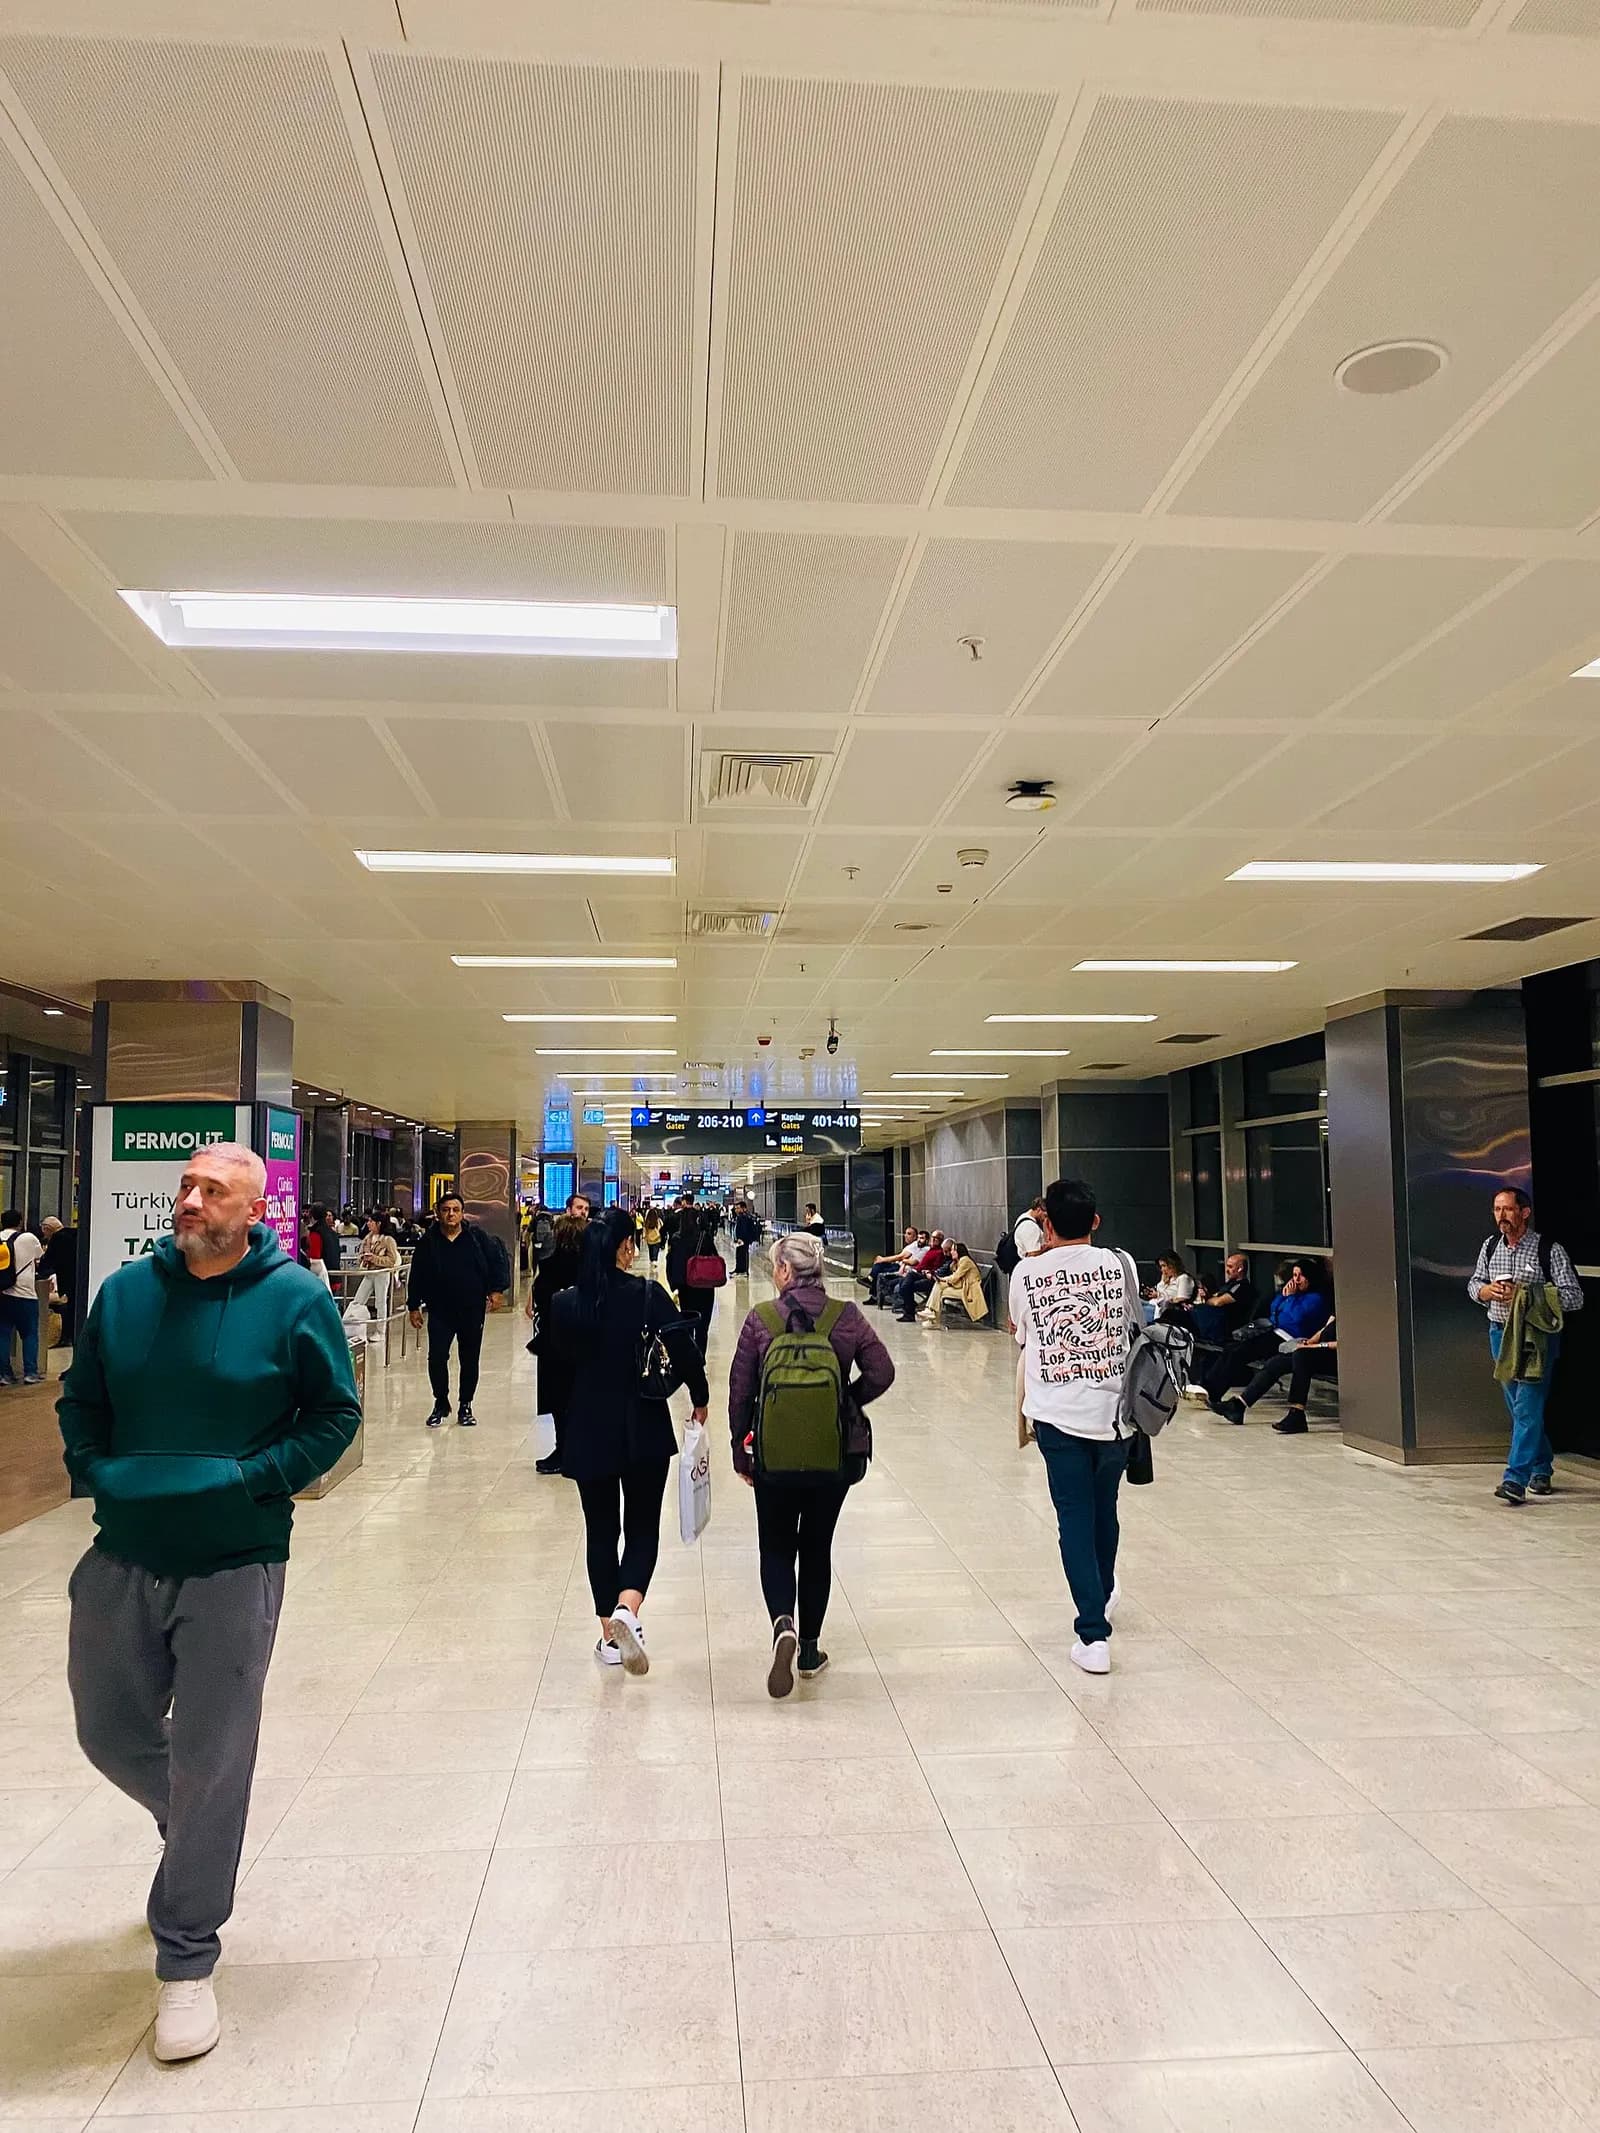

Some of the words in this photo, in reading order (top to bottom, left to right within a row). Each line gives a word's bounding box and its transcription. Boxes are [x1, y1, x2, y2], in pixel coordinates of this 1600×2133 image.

[697, 1115, 744, 1128] 206-210
[781, 1122, 800, 1130] Gates
[811, 1115, 858, 1128] 401-410
[781, 1144, 803, 1154] Masjid
[111, 1192, 177, 1213] Türkiy
[1023, 1275, 1053, 1291] Los
[1055, 1265, 1122, 1286] Angeles
[1028, 1293, 1056, 1310] Los
[1039, 1349, 1065, 1366] Los
[1068, 1341, 1123, 1363] Angeles
[1041, 1369, 1070, 1384] Los
[1071, 1360, 1125, 1383] Angeles
